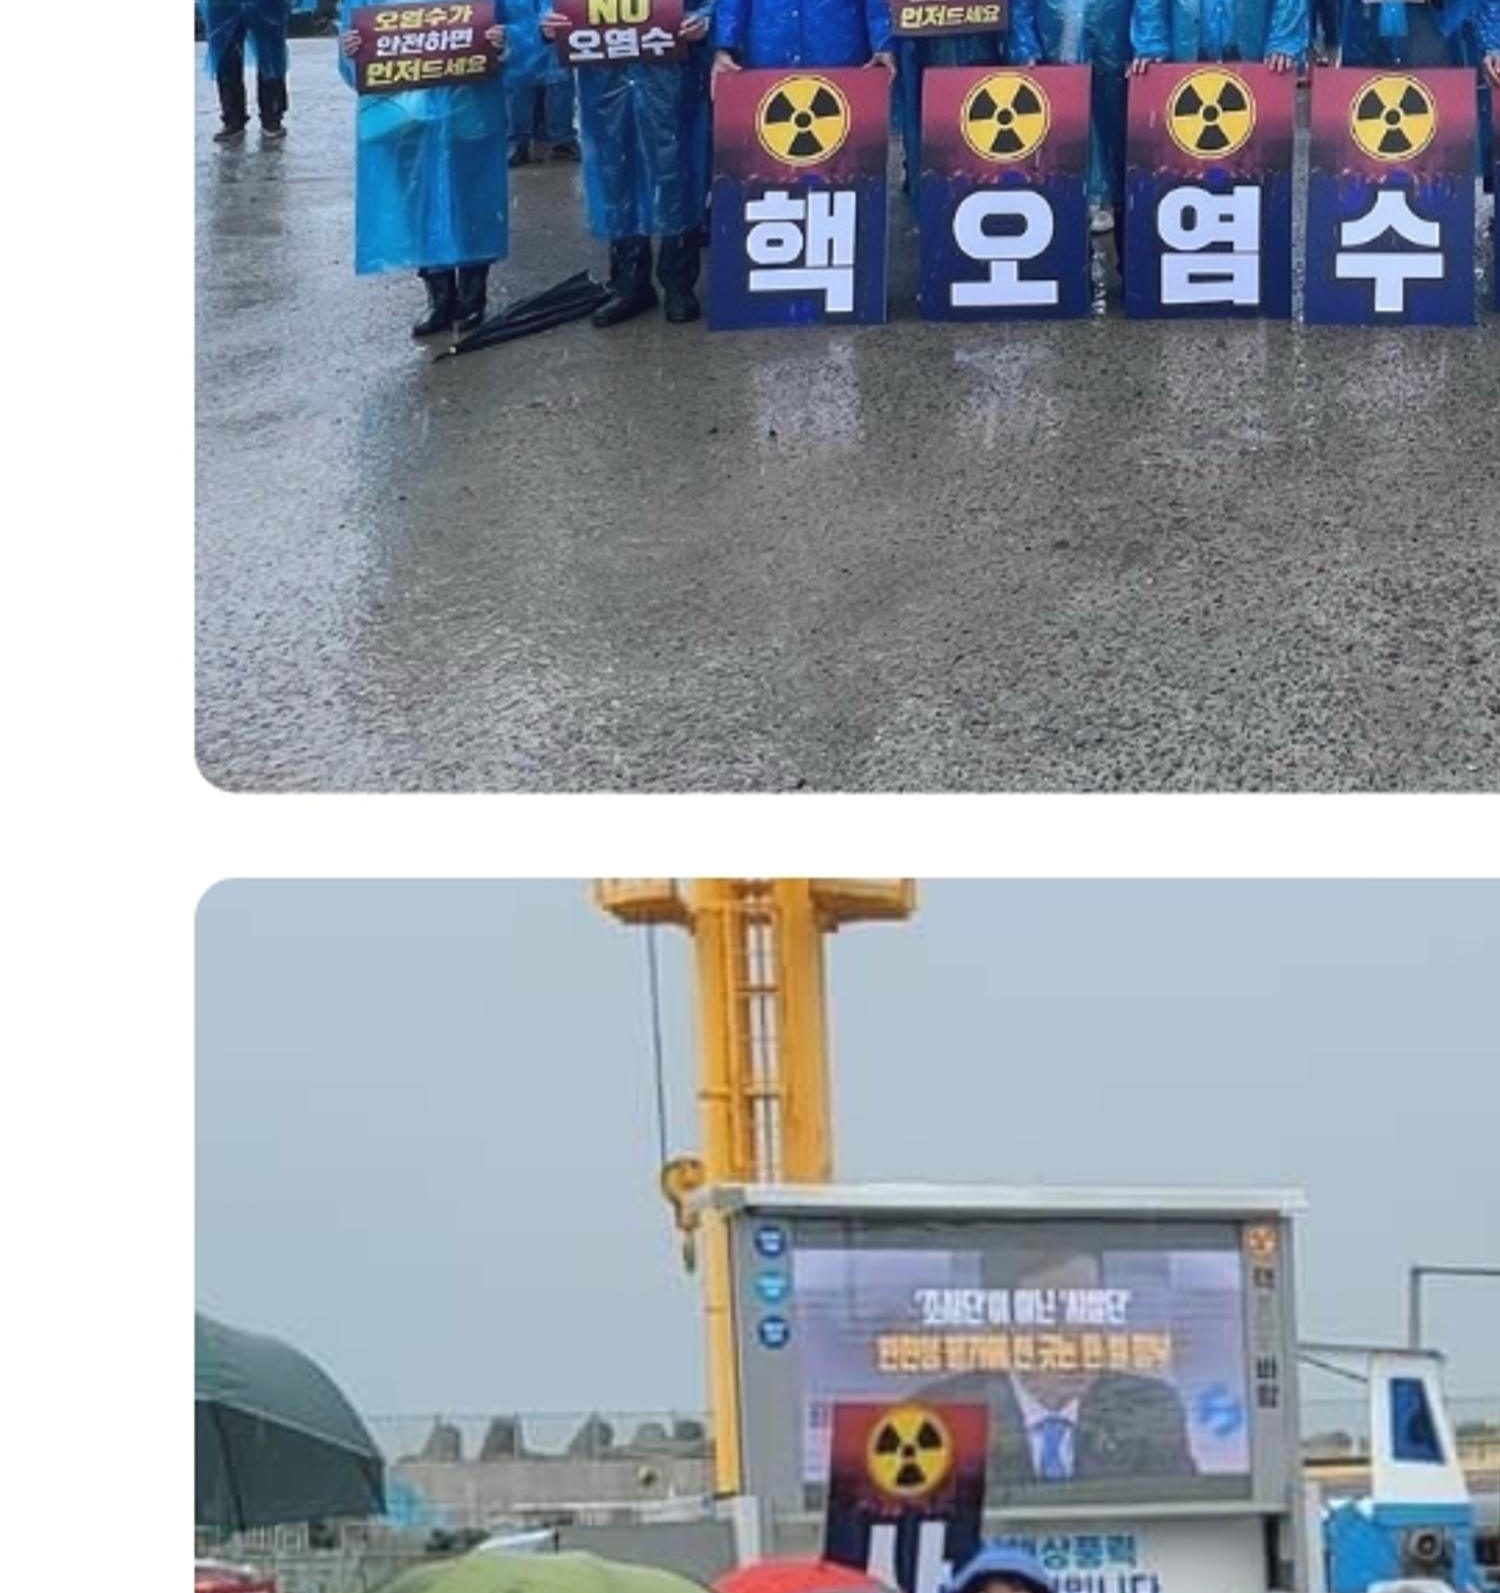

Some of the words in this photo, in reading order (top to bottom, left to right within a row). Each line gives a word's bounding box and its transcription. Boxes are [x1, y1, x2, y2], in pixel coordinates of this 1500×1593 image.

[374, 5, 473, 31] 오염수가
[900, 5, 1000, 28] 먼저드세요
[376, 28, 473, 56] 안전하면
[569, 27, 675, 61] 오염수
[366, 55, 486, 87] 먼저드세요
[745, 190, 856, 313] 핵
[950, 190, 1058, 306] 오
[1157, 185, 1261, 305] 염
[1335, 190, 1442, 312] 수
